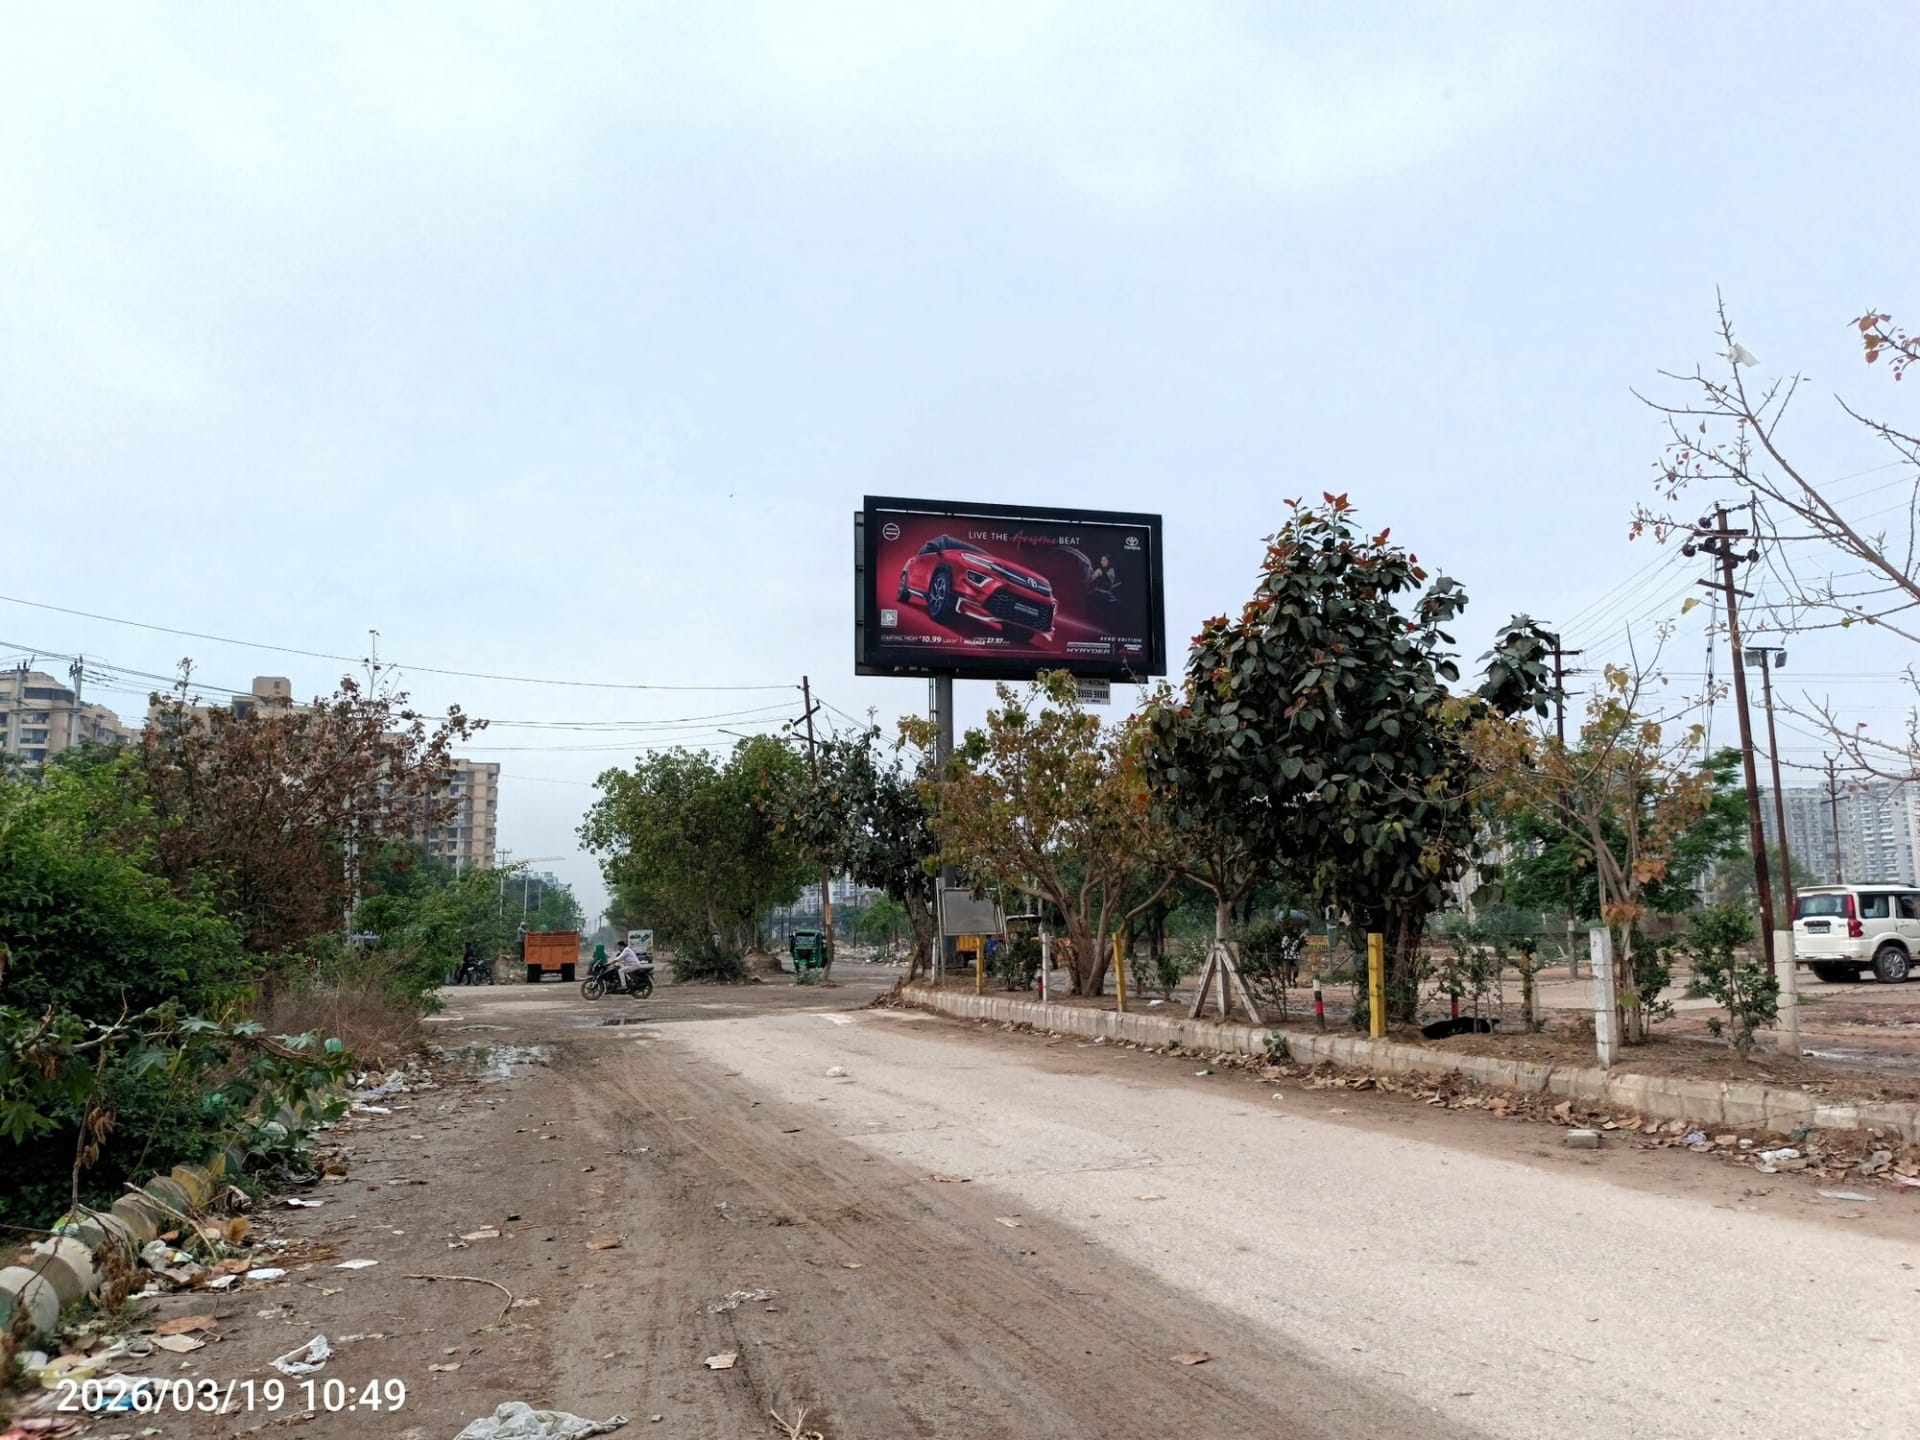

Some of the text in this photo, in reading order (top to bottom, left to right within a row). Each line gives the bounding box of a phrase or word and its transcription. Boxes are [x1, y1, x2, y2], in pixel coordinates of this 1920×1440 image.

[968, 531, 988, 540] LIVE
[991, 532, 1008, 542] THE
[1059, 536, 1080, 545] BEAT
